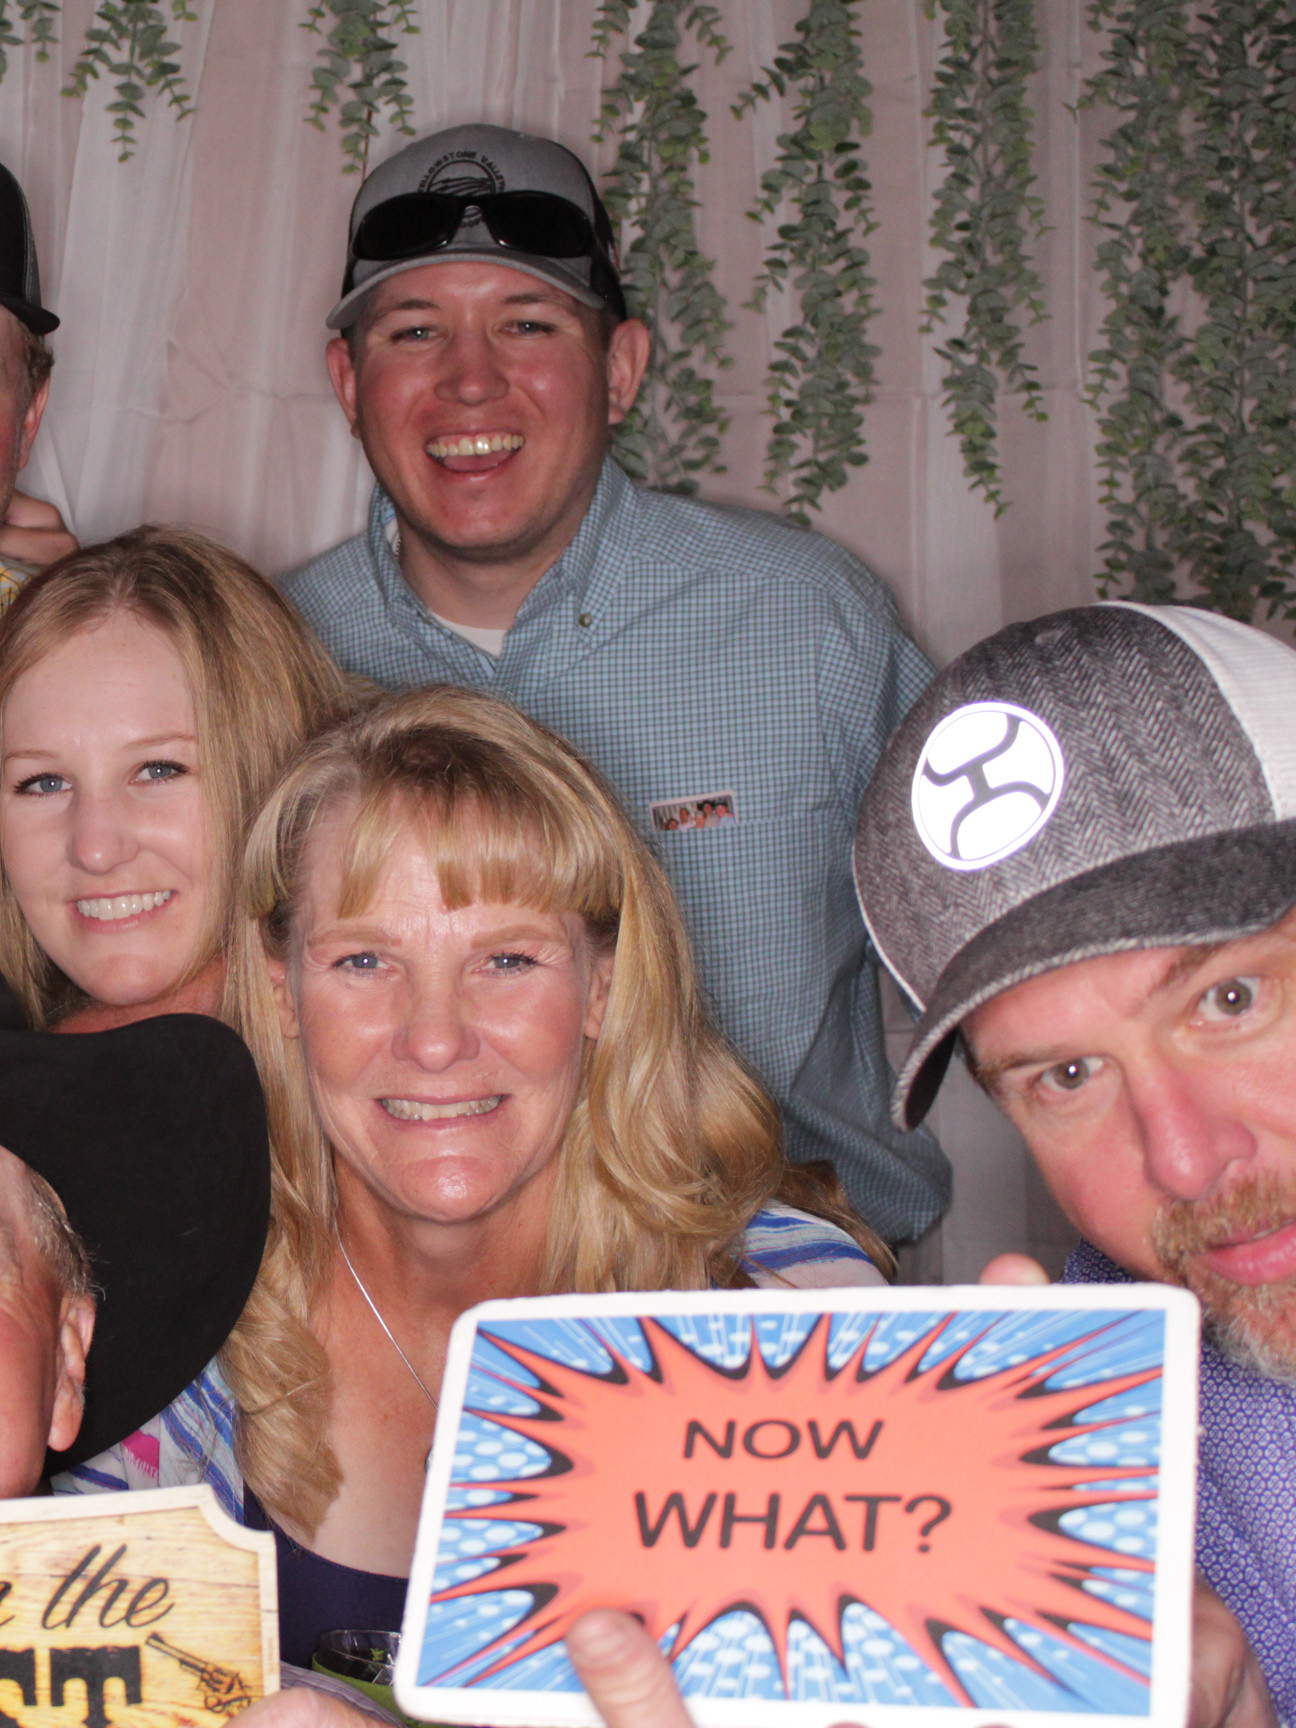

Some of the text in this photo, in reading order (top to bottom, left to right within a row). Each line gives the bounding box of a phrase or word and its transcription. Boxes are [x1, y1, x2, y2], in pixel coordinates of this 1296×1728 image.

[682, 1419, 885, 1461] NOW
[633, 1491, 952, 1554] WHAT?
[40, 1544, 176, 1631] the
